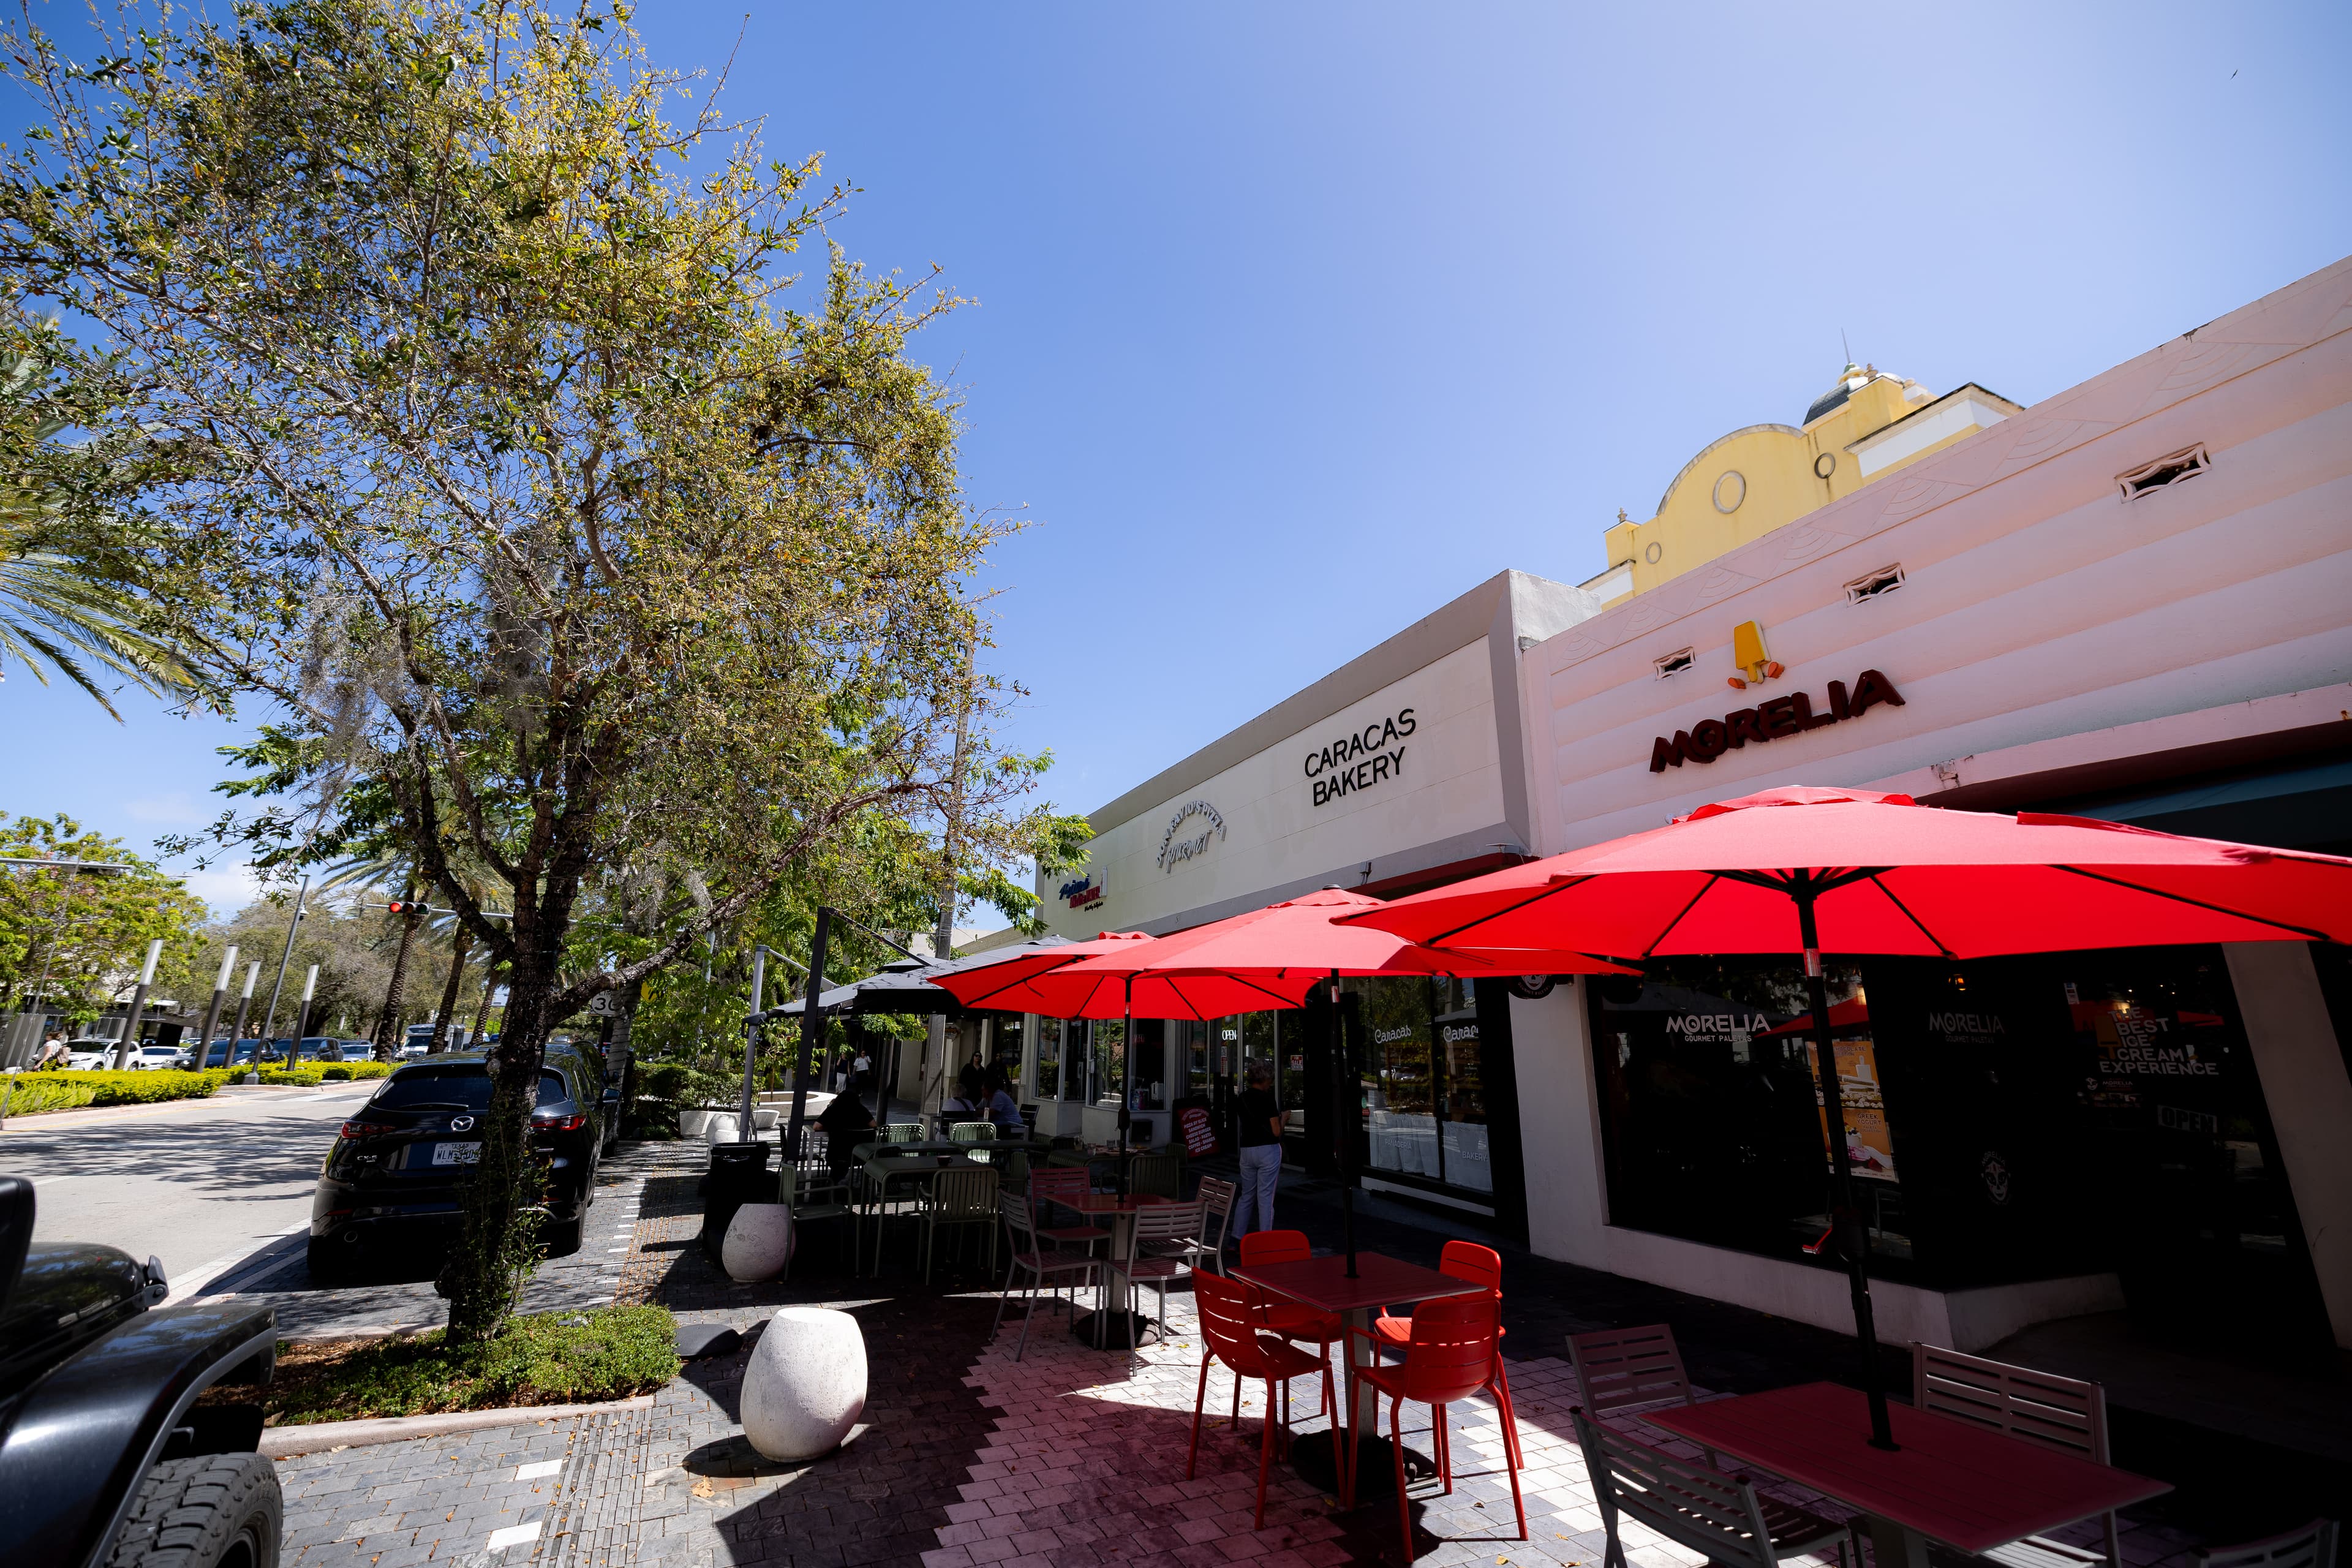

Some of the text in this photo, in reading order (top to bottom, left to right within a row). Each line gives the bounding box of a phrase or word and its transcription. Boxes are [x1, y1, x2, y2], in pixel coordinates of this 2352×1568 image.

[1649, 669, 1905, 772] MORELIA
[1305, 709, 1417, 777] CARACAS
[1313, 747, 1405, 806] BAKERY
[1202, 803, 1227, 841] PIZZA
[1928, 1011, 2005, 1034] MORELIA
[2107, 1006, 2144, 1022] THE
[1374, 1025, 1412, 1044] Caracas
[1666, 1014, 1771, 1035] MORELIA
[2116, 1017, 2169, 1036] BEST
[1222, 1030, 1237, 1040] OPEN
[2121, 1036, 2150, 1048] ICE
[2117, 1048, 2185, 1061] CREAM
[2099, 1061, 2220, 1076] EXPERIENCE
[2163, 1107, 2214, 1133] OPEN
